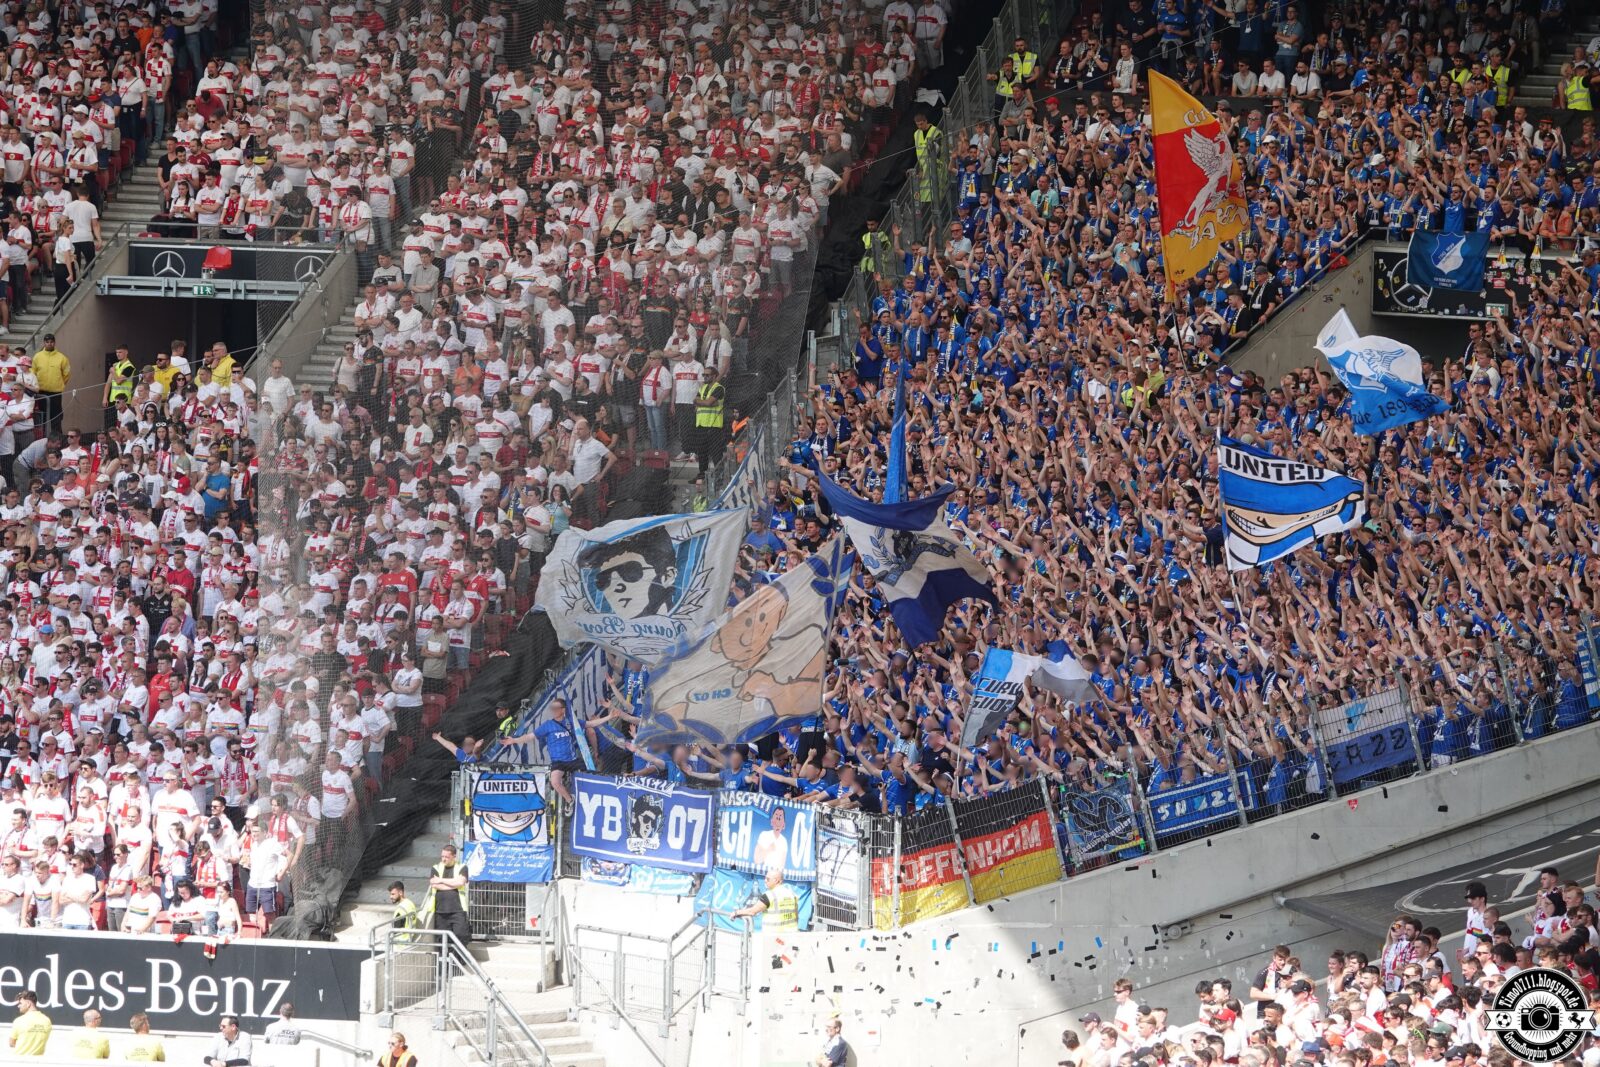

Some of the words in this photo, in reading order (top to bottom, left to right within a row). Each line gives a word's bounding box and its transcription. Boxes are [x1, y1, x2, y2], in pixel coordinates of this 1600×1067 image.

[1225, 448, 1325, 481] UNITED
[483, 781, 529, 792] UNITED
[579, 791, 622, 842] YB
[667, 804, 707, 853] 07
[721, 810, 753, 860] CH
